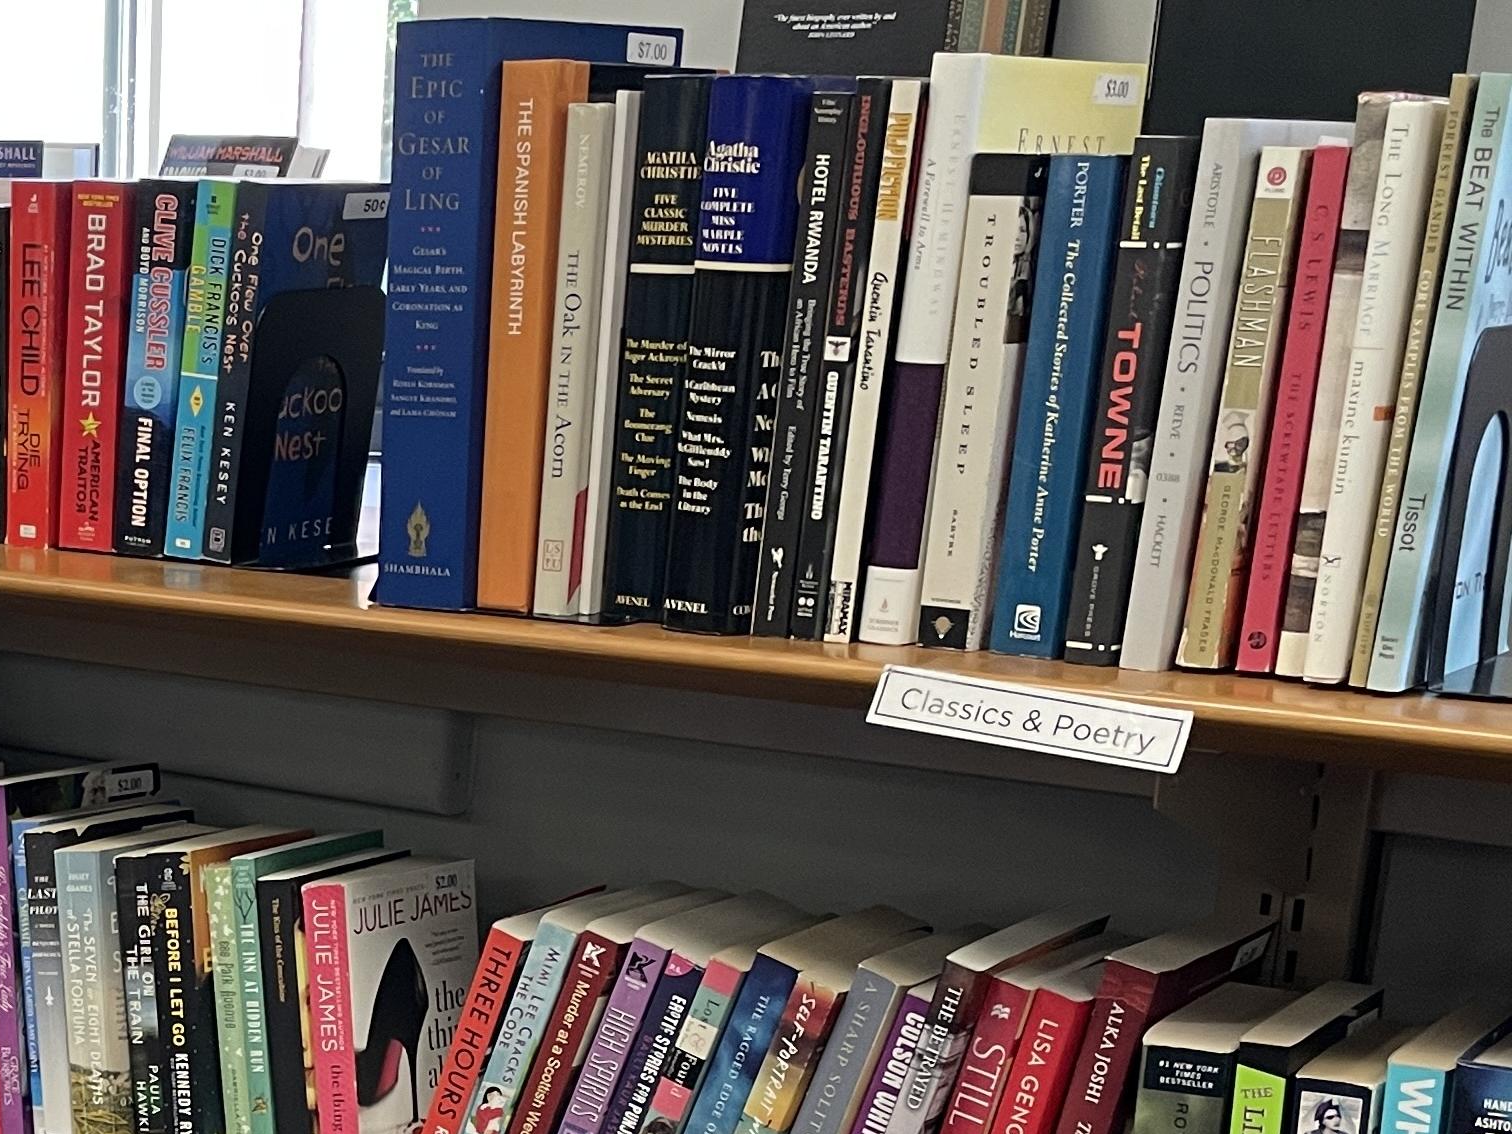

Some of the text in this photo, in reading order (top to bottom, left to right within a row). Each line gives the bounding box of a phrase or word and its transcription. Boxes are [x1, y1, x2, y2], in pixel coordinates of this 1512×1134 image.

[638, 42, 668, 61] $7.00
[1105, 79, 1131, 99] $3.00
[292, 226, 346, 266] One
[363, 199, 386, 213] 50¢
[509, 98, 533, 335] THE SPANISH LABYRINTH
[801, 154, 831, 285] HOTEL RWANDA
[1070, 162, 1090, 229] PORTER
[1446, 106, 1501, 312] The BEAT WITHIN
[21, 243, 42, 396] LEE CHILD
[81, 214, 107, 407] BRAD TAYLOR
[144, 193, 179, 372] CLIVE CUSSLER
[1177, 260, 1214, 374] POLITICS
[1233, 235, 1283, 368] FLASHMAN
[957, 214, 997, 475] TROUBLED SLEEP
[216, 402, 236, 505] KEN KESEY
[1097, 322, 1144, 489] TOWNE
[1399, 493, 1427, 552] Tissot
[900, 687, 1156, 755] Classics & Poetry
[117, 777, 142, 792] $2.00
[354, 889, 472, 936] JULIE JAMES
[435, 874, 458, 889] $2.00
[311, 900, 338, 1052] JULIE JAMES
[436, 948, 512, 1121] THREE HOURS
[948, 1035, 1006, 1128] STILL
[1026, 1019, 1059, 1068] LISA
[1084, 1001, 1126, 1104] ALKA JOSHI
[148, 1065, 160, 1116] PAULA
